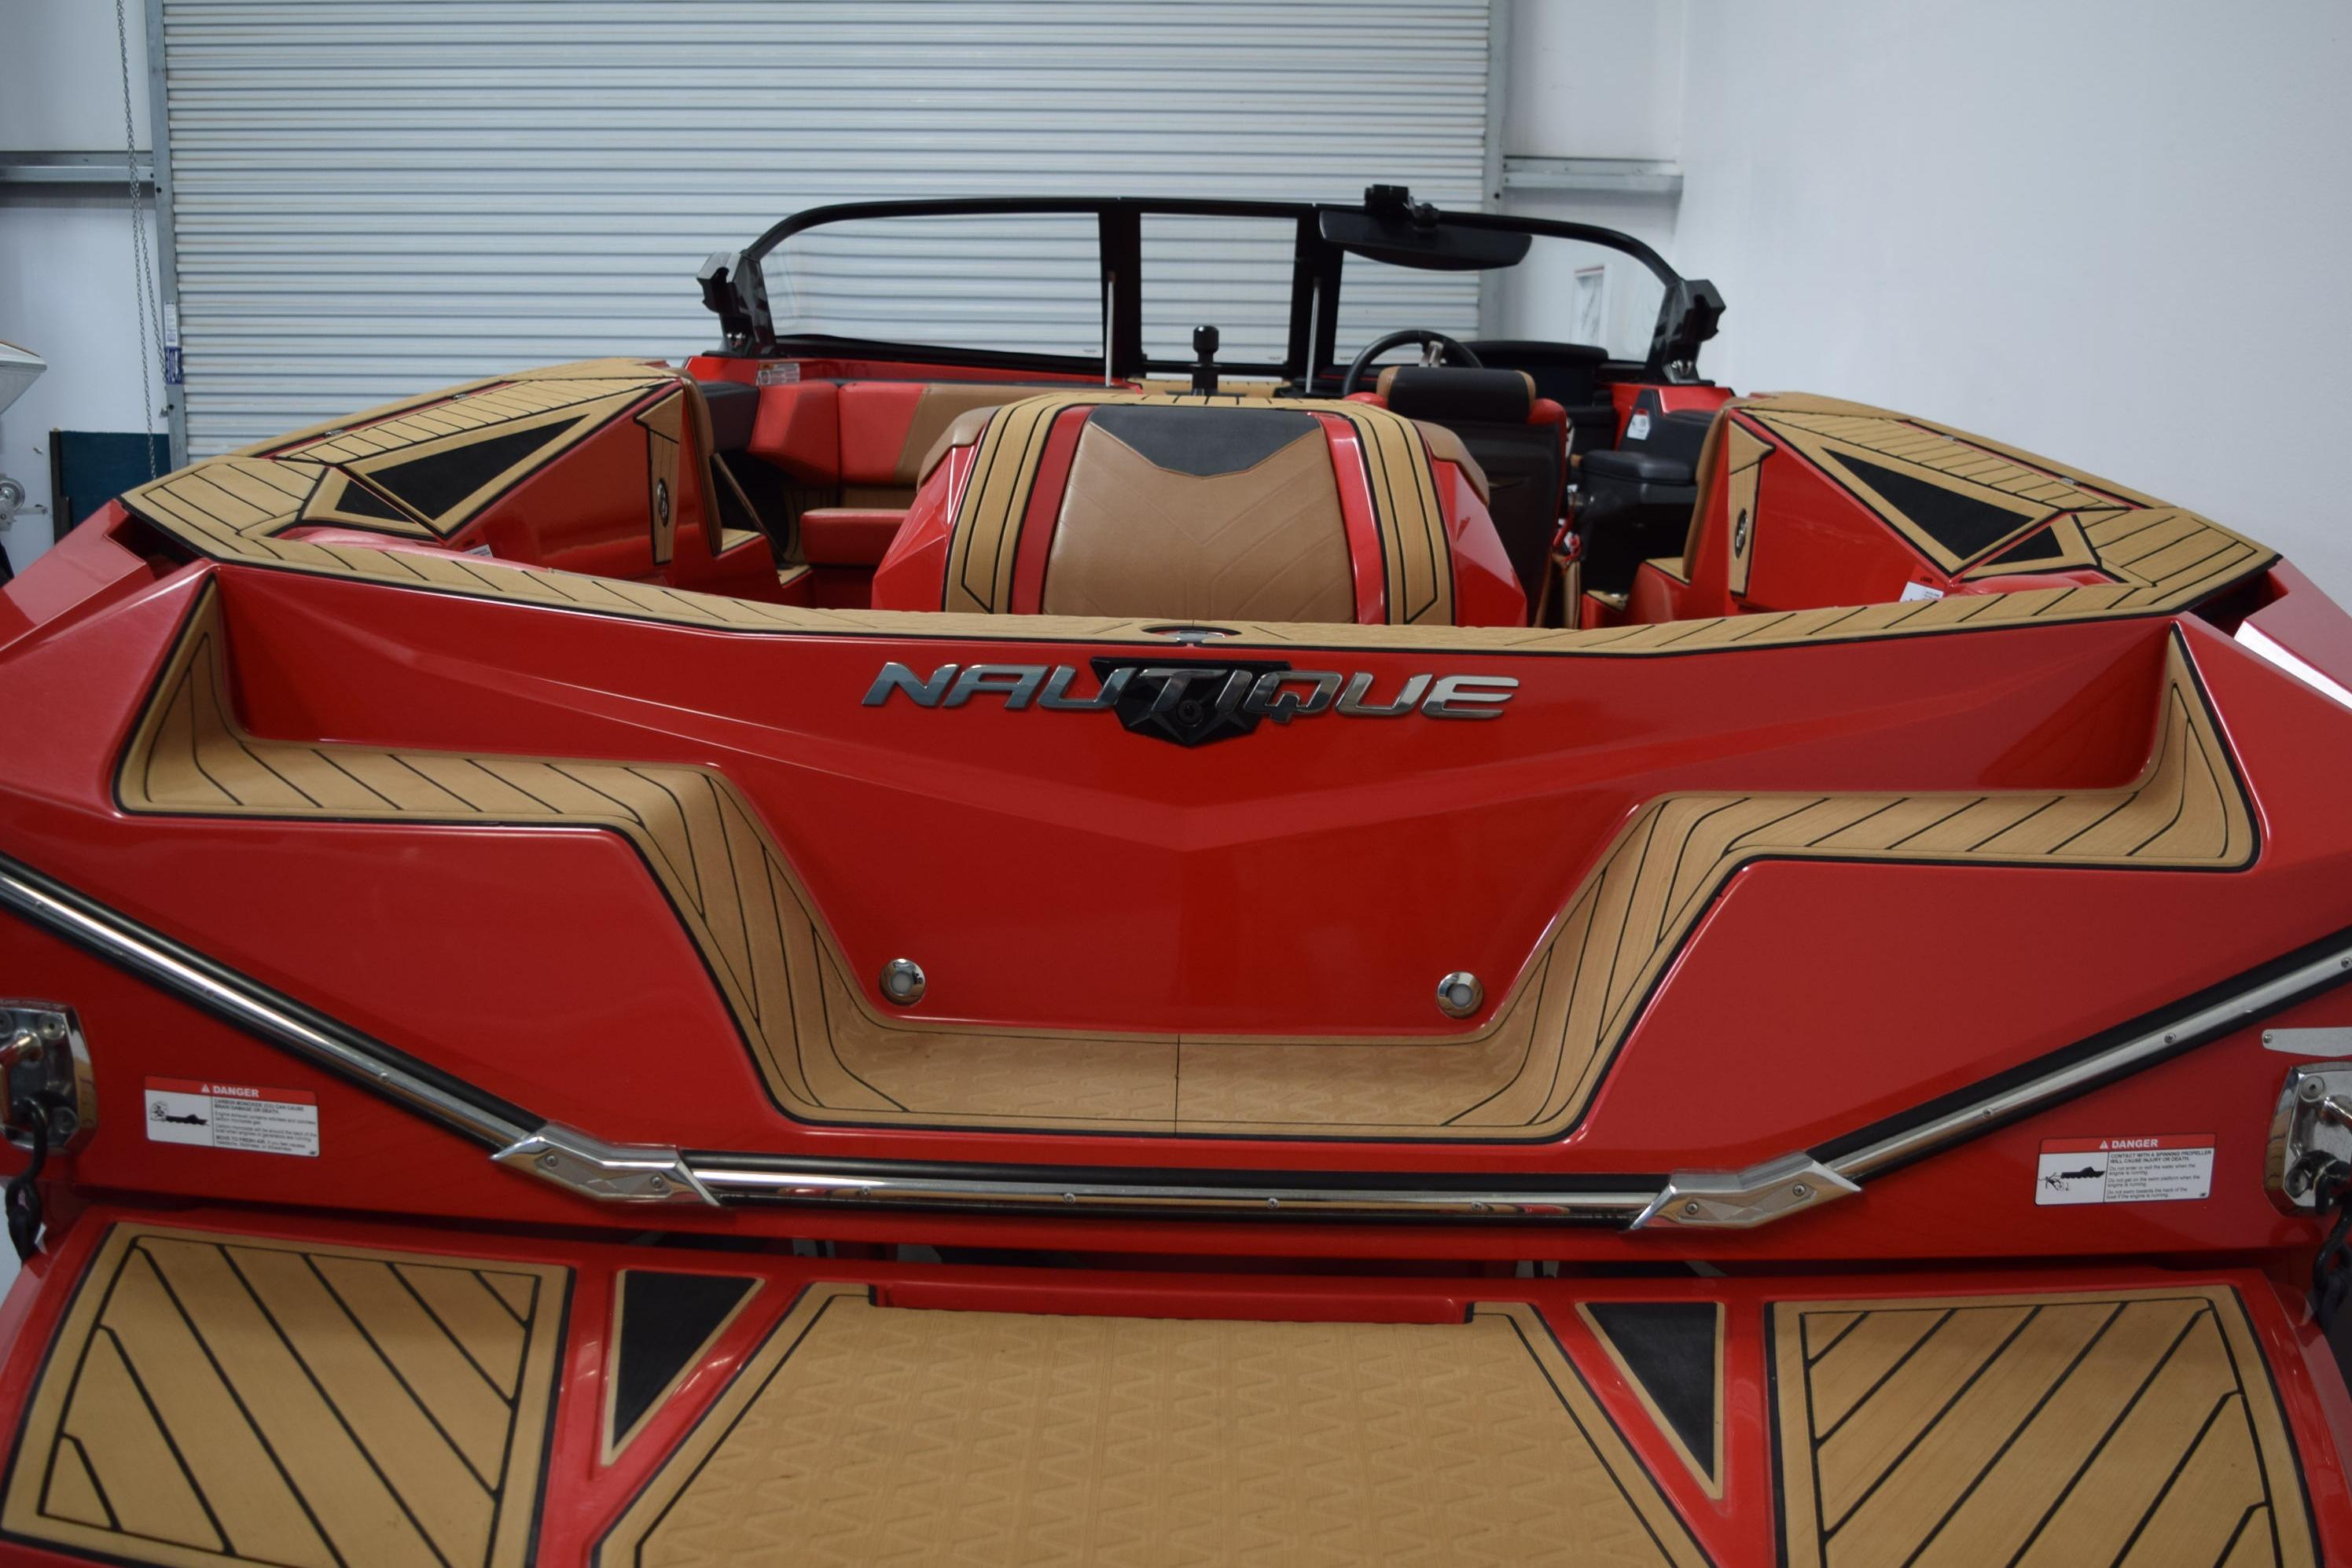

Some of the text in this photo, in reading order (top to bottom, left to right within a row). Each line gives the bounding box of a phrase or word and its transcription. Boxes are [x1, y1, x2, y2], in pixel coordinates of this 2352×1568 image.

[862, 662, 1520, 724] NAUTIQUE
[213, 1085, 259, 1098] DANGER
[2111, 1139, 2159, 1148] DANGER
